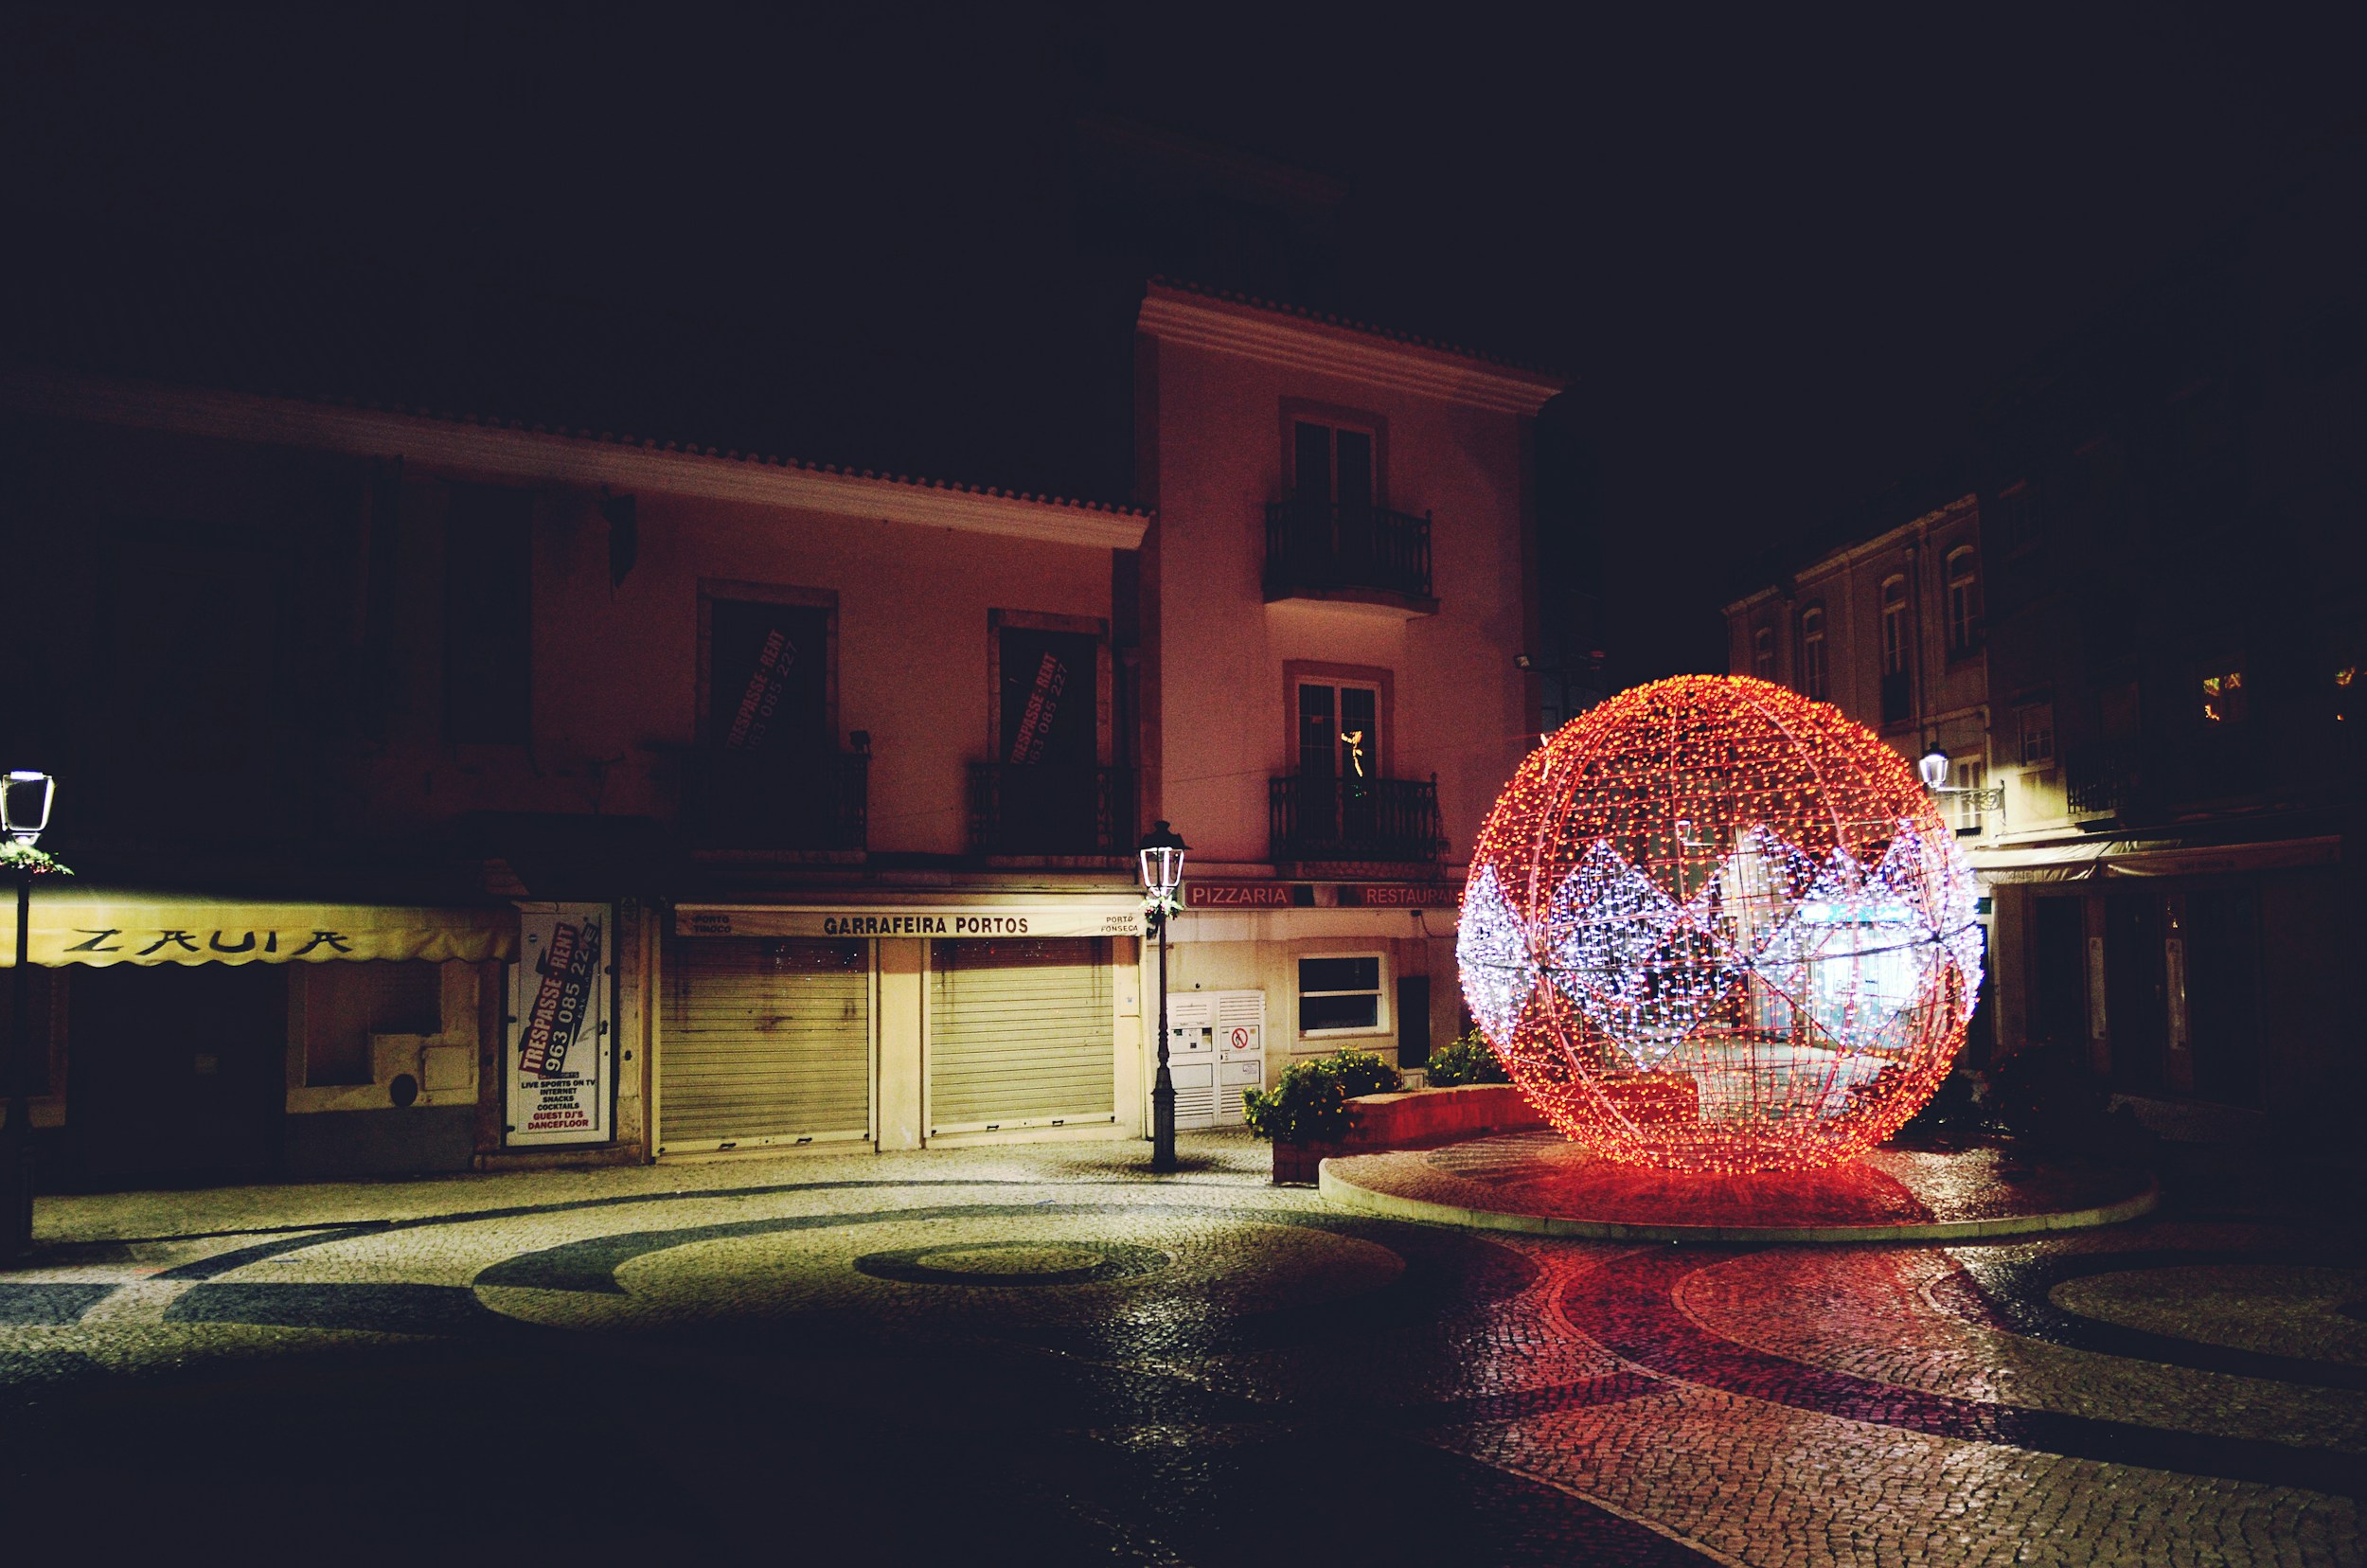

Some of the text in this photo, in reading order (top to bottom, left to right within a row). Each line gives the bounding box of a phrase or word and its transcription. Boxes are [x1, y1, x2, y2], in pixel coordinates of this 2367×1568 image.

[759, 629, 786, 668] RENT
[760, 681, 782, 718] 085
[776, 640, 797, 678] 227
[1010, 650, 1059, 765] TRESPASSE RENT
[1039, 700, 1058, 734] 085
[1051, 663, 1068, 697] 227
[1192, 887, 1288, 904] PIZZARIA
[1366, 888, 1459, 904] RESTAURAN
[693, 915, 730, 924] PORTO
[824, 917, 1028, 935] GARRAFEIRA PORTOS
[1101, 924, 1138, 933] FONSECA
[523, 976, 563, 1071] TRESPASSE
[550, 925, 577, 970] RENT
[545, 1030, 568, 1071] 963
[558, 983, 580, 1024] 085
[570, 944, 590, 976] 22
[527, 1119, 589, 1130] DANCEFLOOR
[533, 1112, 562, 1120] GUEST
